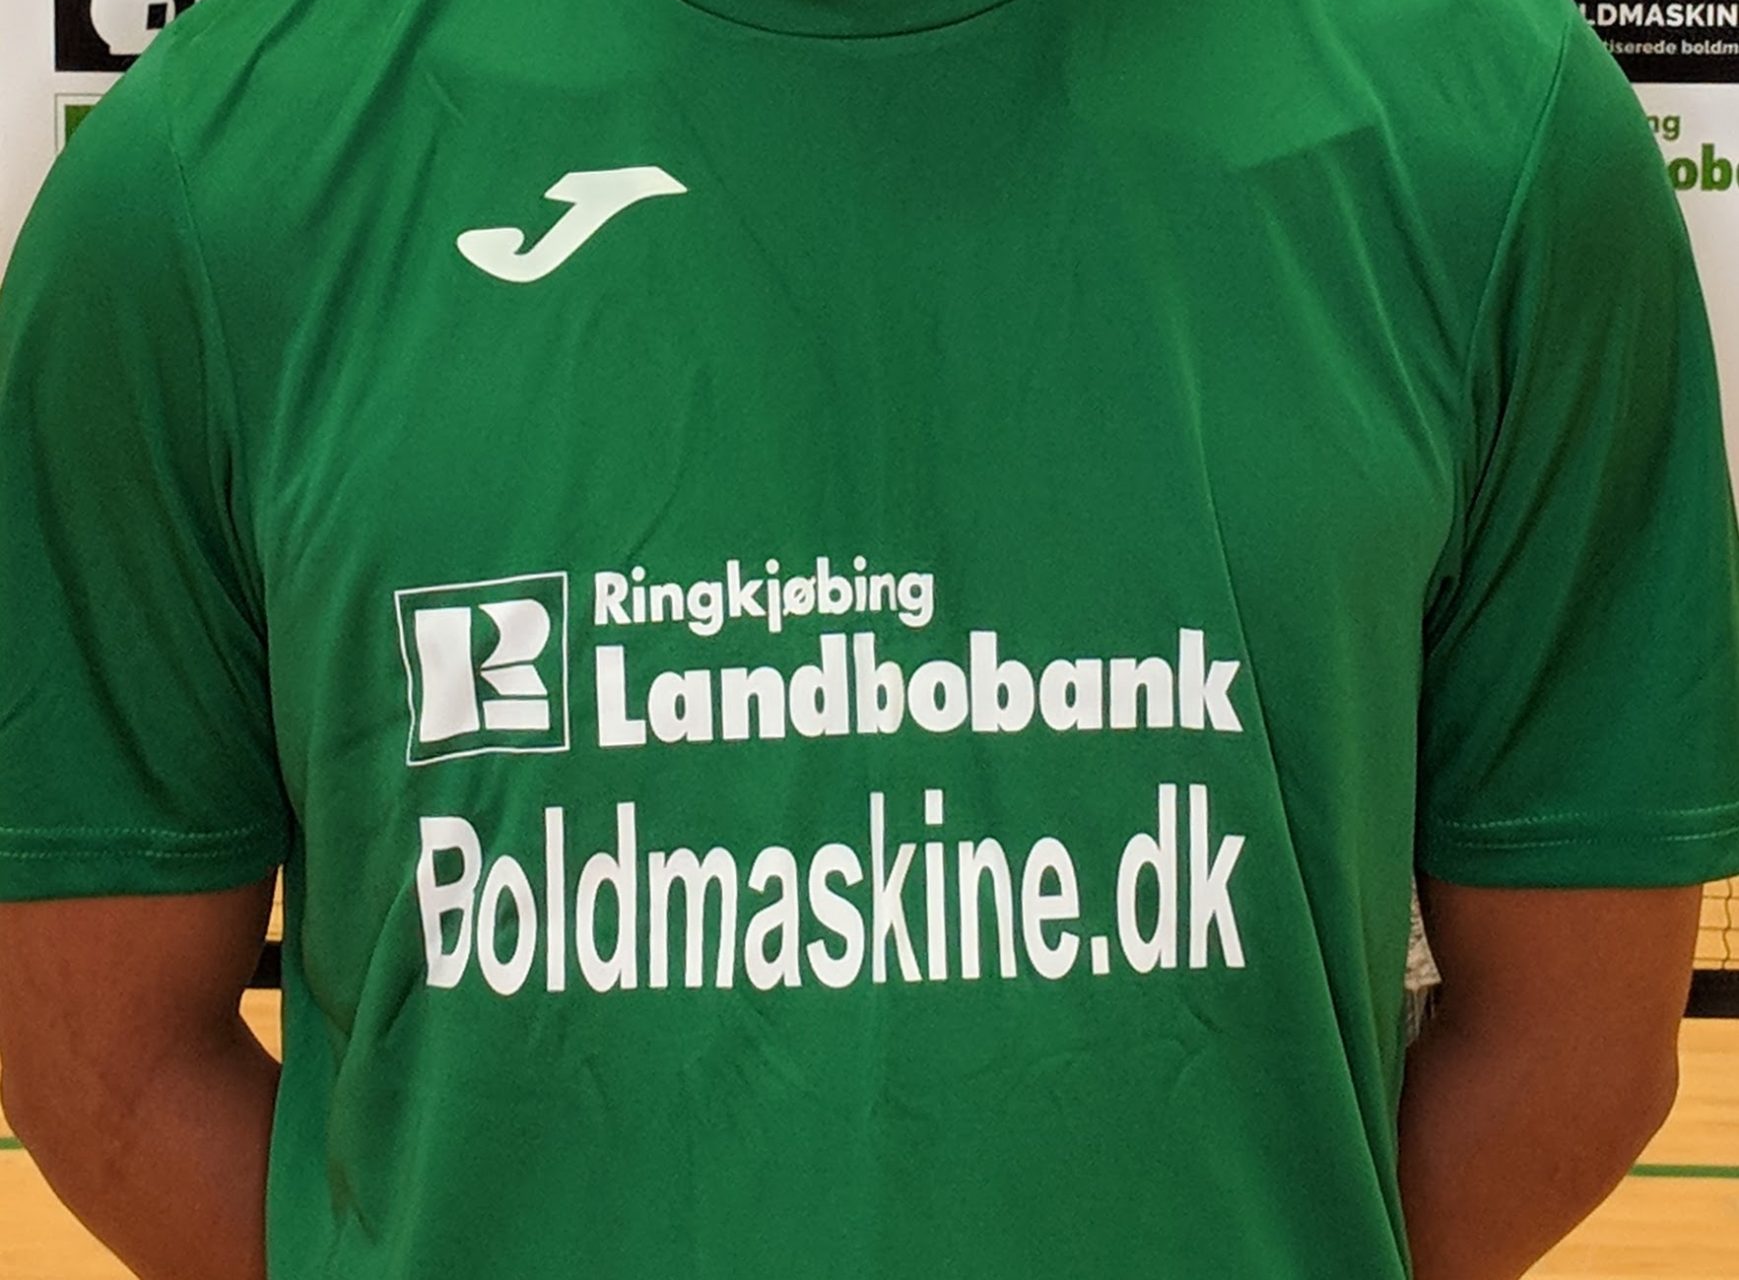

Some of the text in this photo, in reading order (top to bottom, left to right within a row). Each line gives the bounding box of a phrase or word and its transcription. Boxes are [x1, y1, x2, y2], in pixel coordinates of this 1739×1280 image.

[1580, 3, 1739, 27] LDMASKIN
[1605, 40, 1678, 55] tiserede
[595, 556, 934, 635] Ringkjøbing
[596, 628, 1243, 746] Landbobank
[417, 784, 1244, 995] Boldmaskine.dk
